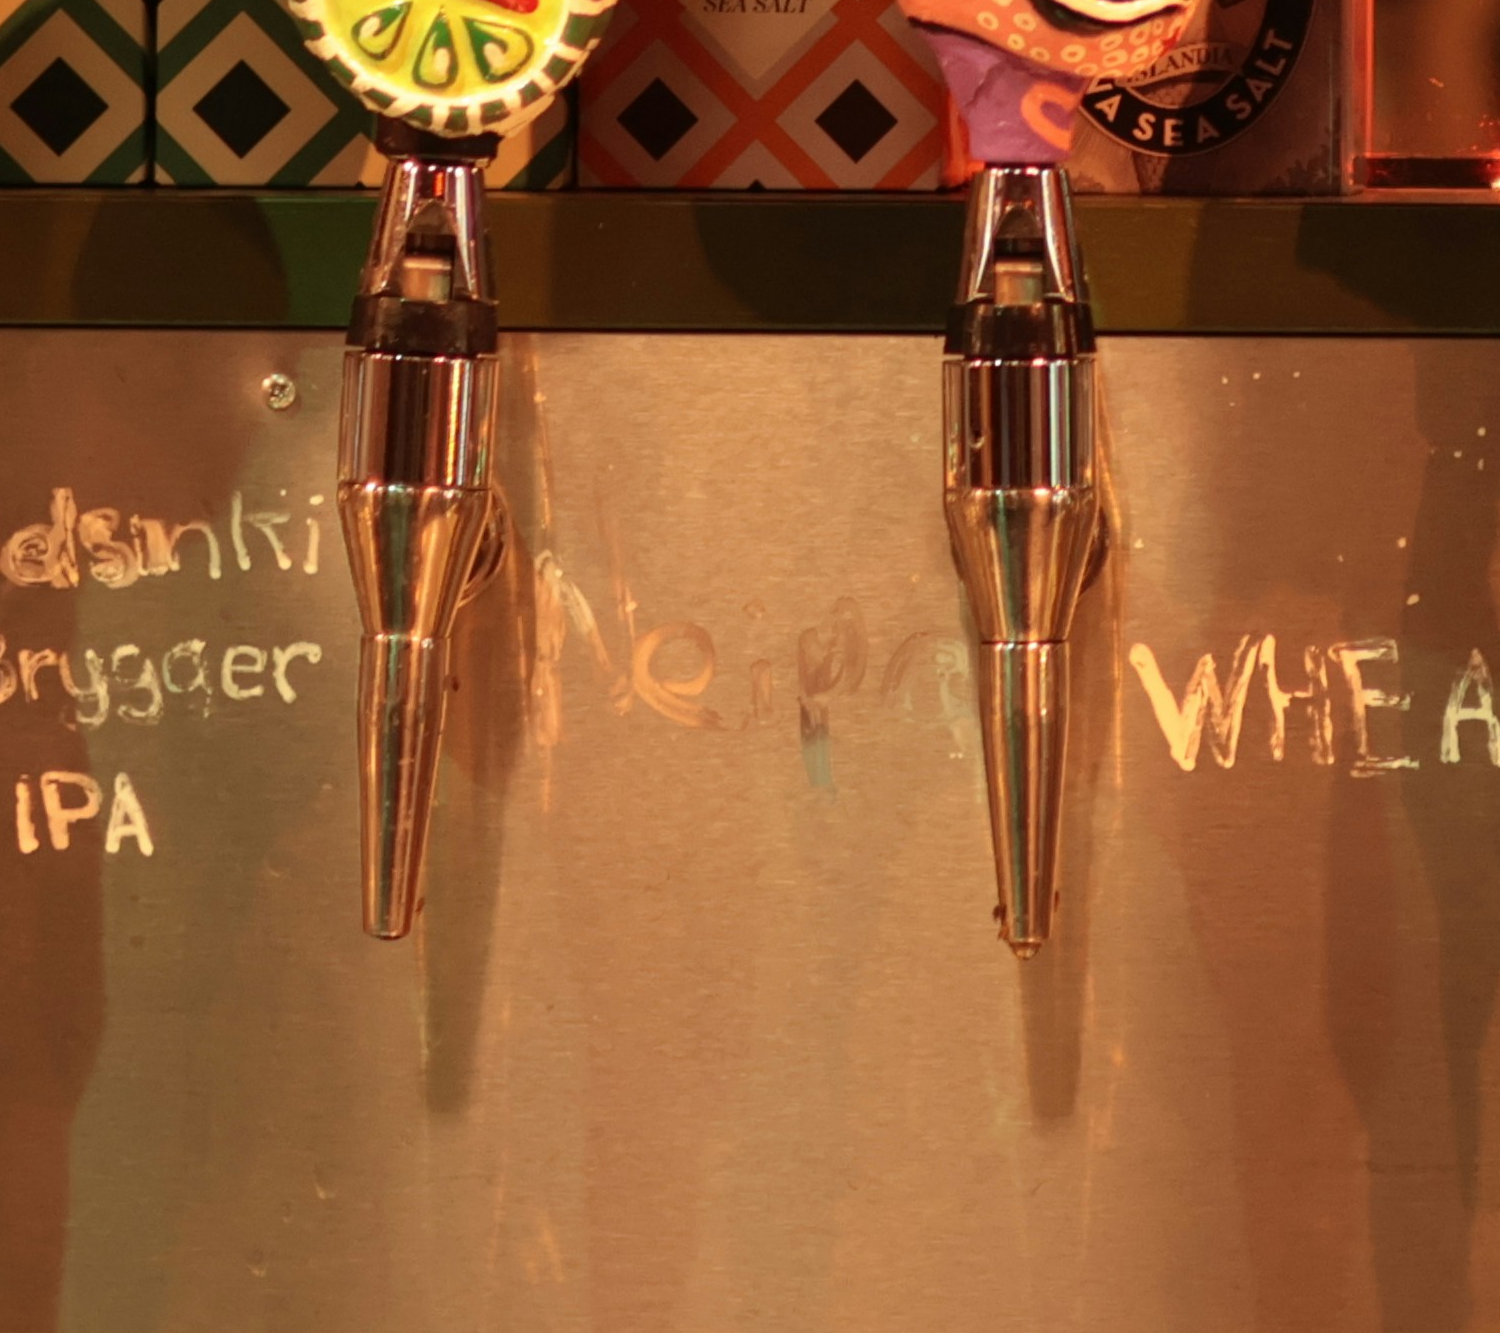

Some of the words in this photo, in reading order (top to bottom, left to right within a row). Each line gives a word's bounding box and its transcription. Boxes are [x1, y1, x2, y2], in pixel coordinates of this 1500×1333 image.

[1132, 111, 1222, 148] SEA
[1225, 30, 1295, 122] SALT
[13, 770, 155, 858] IPA
